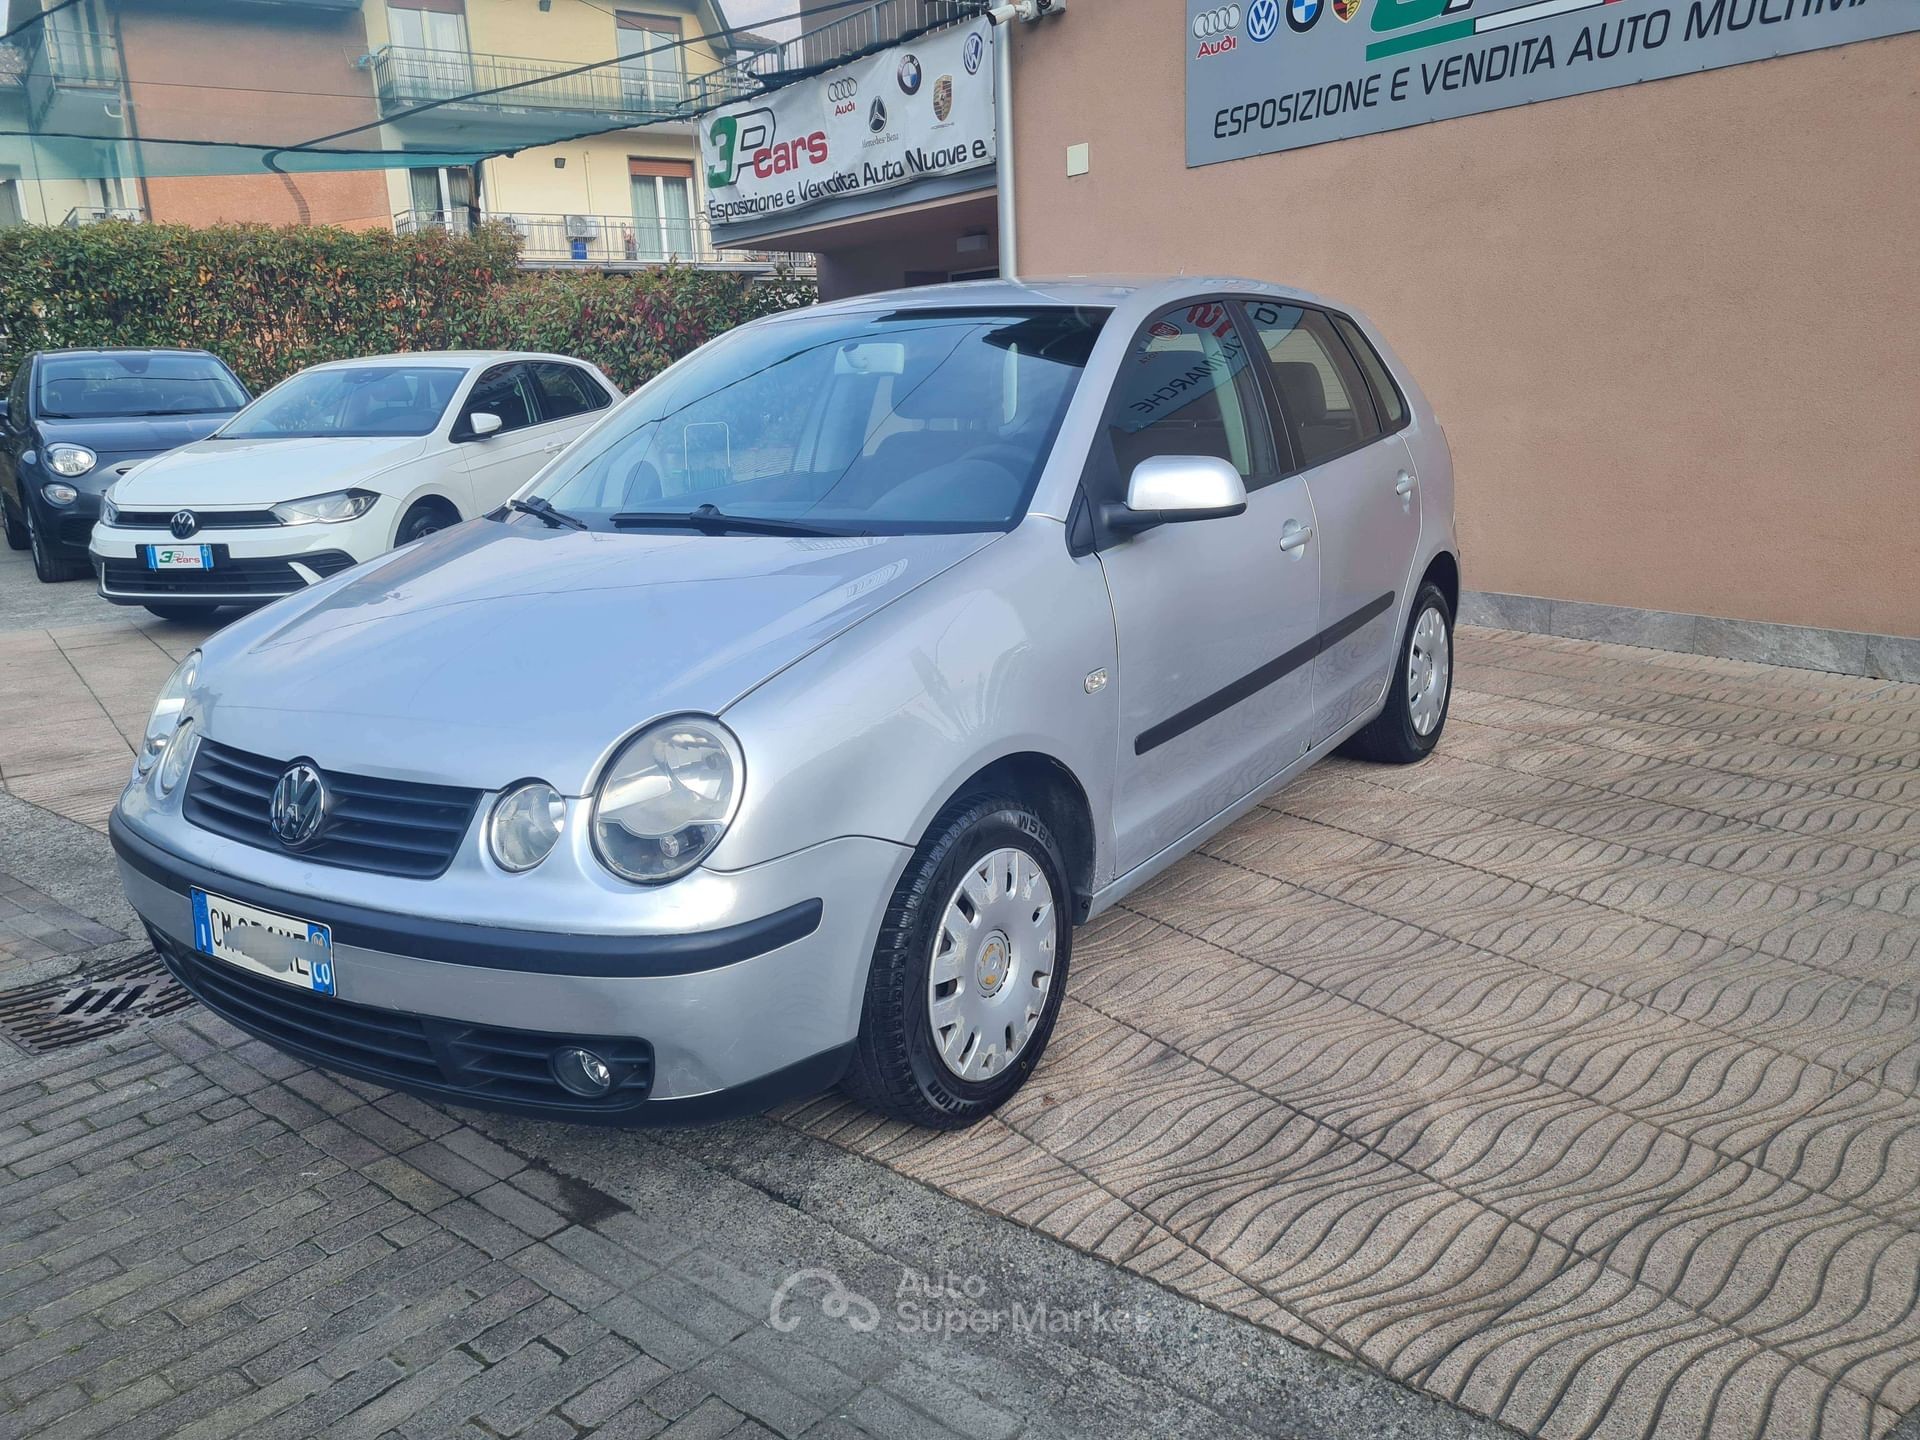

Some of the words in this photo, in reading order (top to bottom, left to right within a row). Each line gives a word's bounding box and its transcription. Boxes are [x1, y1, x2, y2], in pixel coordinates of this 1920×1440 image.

[1196, 36, 1237, 59] Audi
[1214, 73, 1382, 139] ESPOSIZIONE
[1390, 66, 1410, 102] E
[1421, 34, 1556, 96] VENDITA
[1566, 9, 1671, 66] AUTO
[834, 101, 856, 117] Audi
[708, 191, 783, 222] Esposizione
[786, 189, 796, 205] e
[798, 170, 860, 201] Vendita
[863, 161, 905, 187] Auto
[905, 143, 967, 173] Nuove
[972, 139, 987, 159] e
